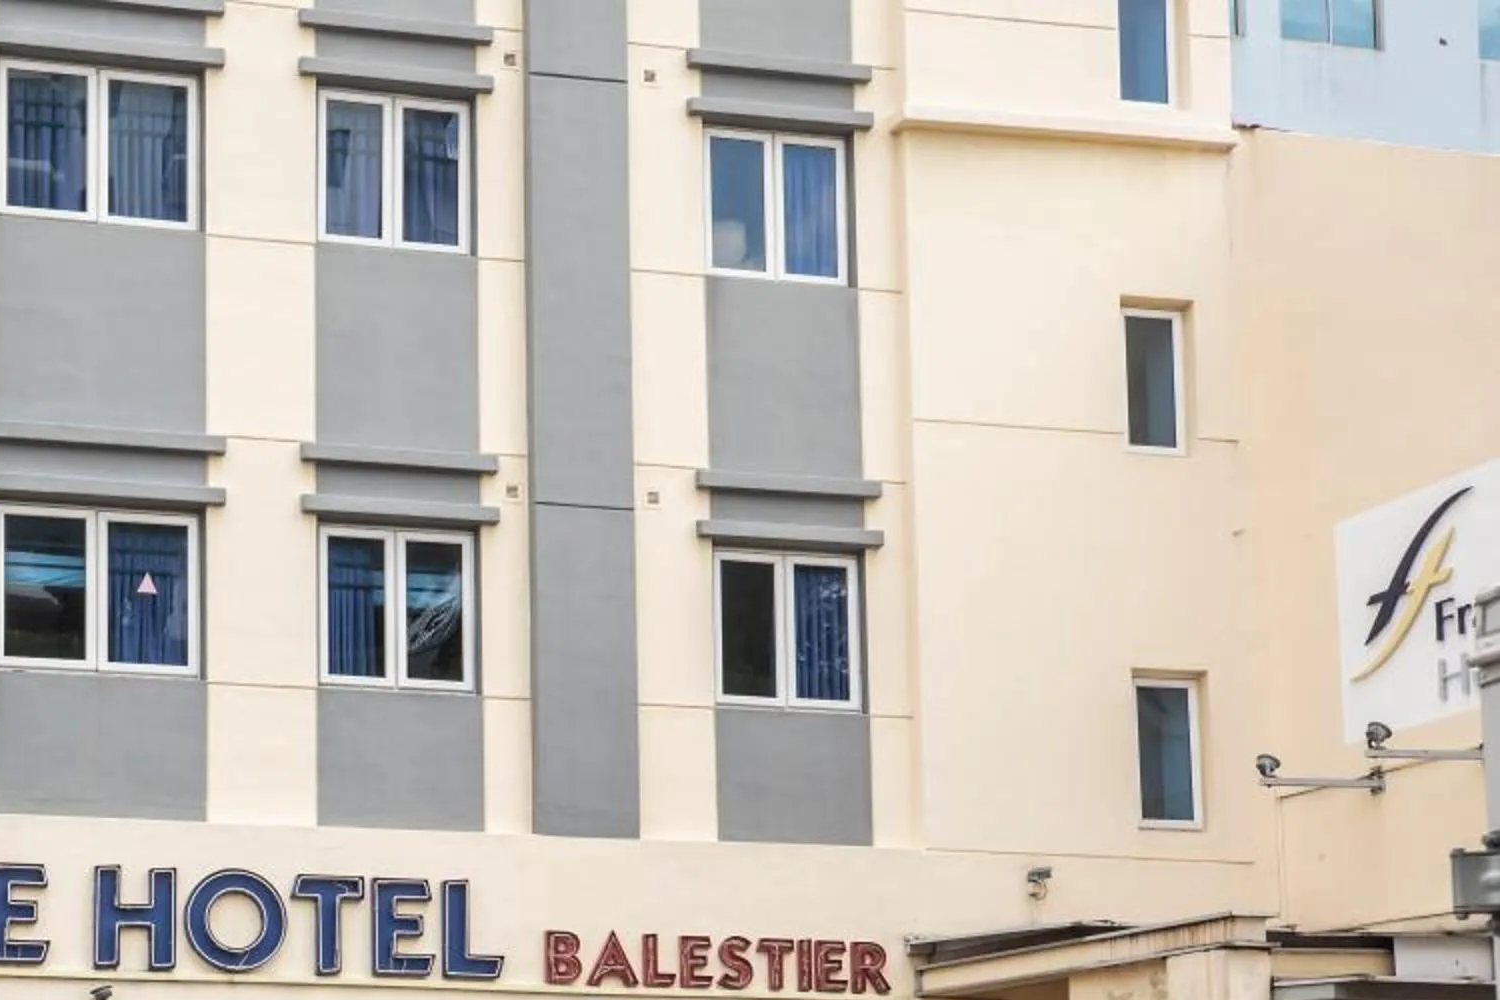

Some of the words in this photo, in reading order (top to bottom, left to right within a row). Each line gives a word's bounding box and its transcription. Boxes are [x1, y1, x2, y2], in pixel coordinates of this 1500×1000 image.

[1435, 597, 1476, 641] Fr
[92, 864, 505, 980] HOTEL
[544, 929, 892, 995] BALESTIER
